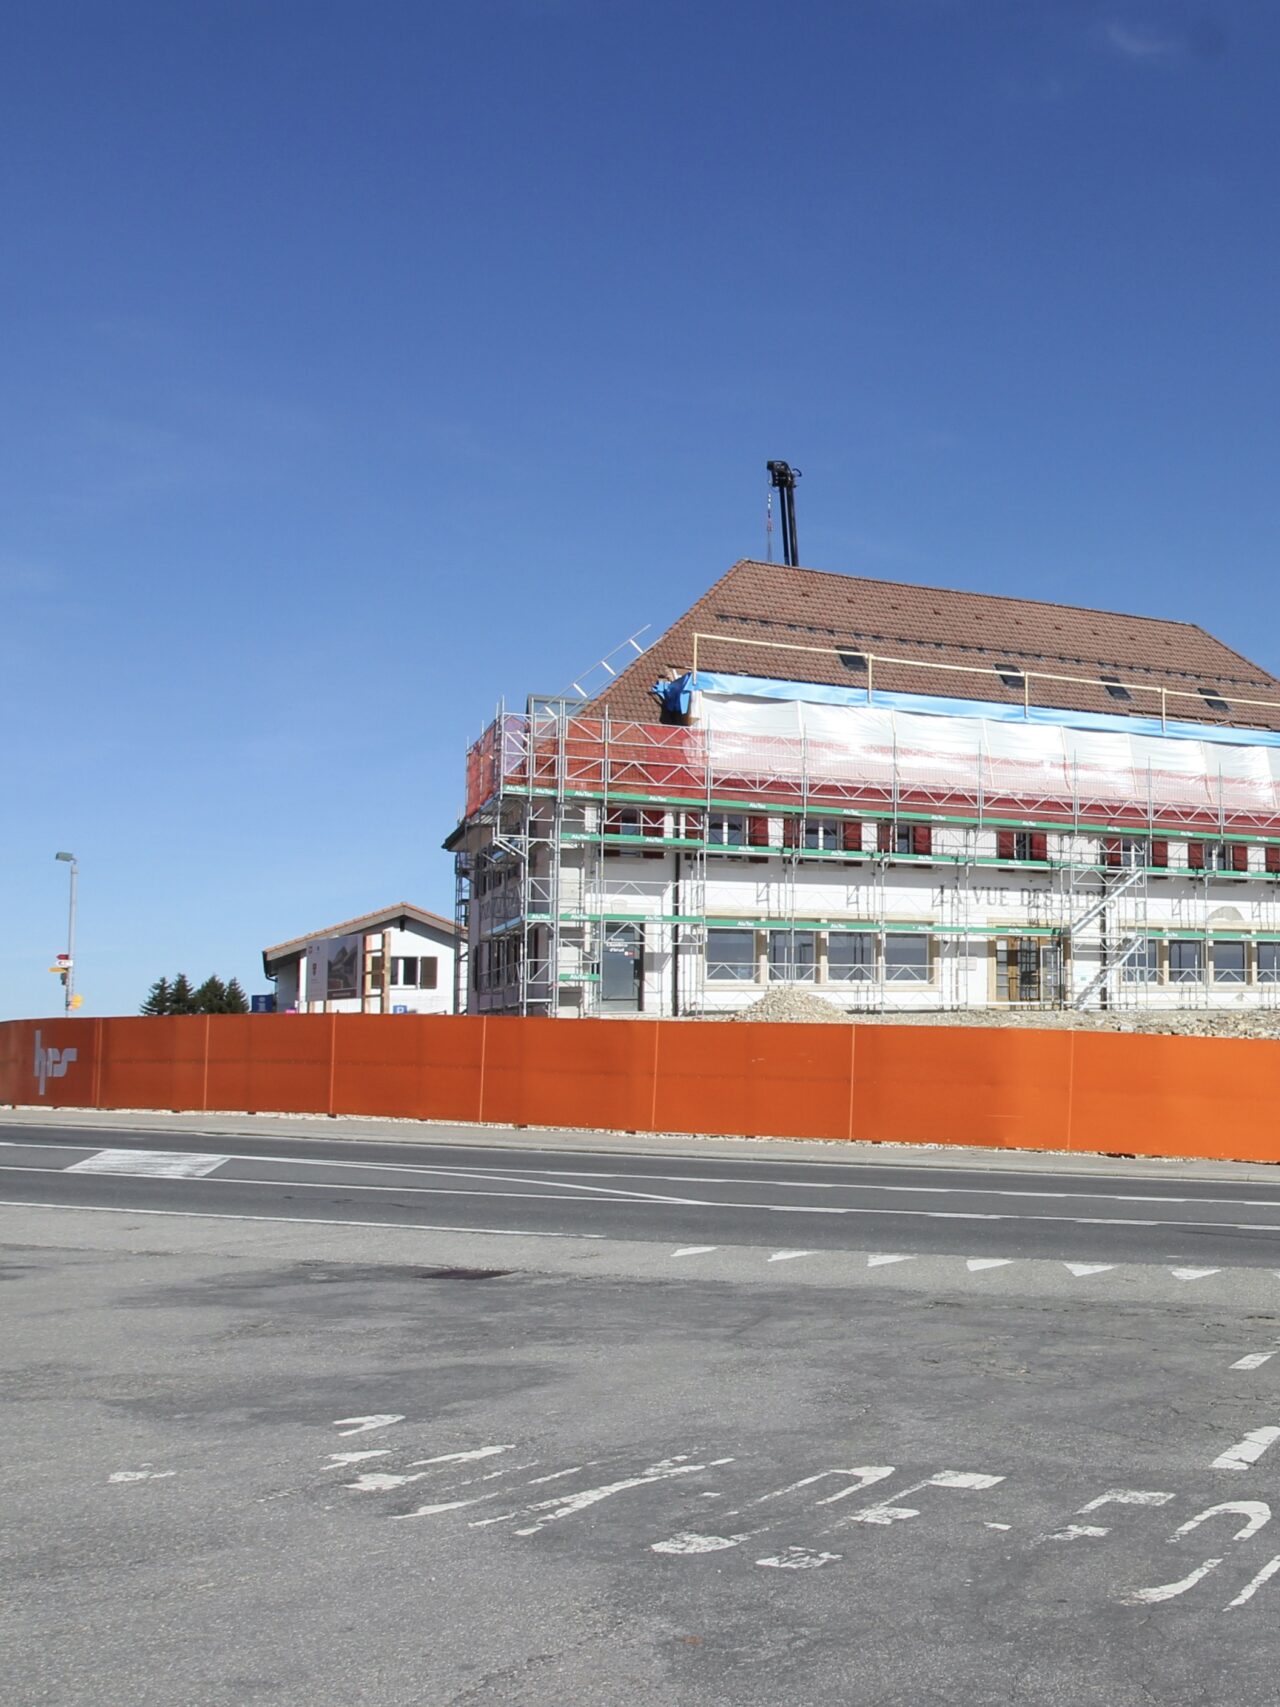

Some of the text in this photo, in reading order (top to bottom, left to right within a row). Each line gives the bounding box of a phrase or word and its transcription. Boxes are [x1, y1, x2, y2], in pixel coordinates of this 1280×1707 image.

[505, 785, 526, 793] AluTec
[534, 787, 555, 795] AluTec
[574, 790, 594, 798] AluTec
[648, 794, 667, 802] AluTec
[571, 833, 590, 841] AluTec
[972, 886, 1009, 906] VUE
[1020, 888, 1052, 909] DES
